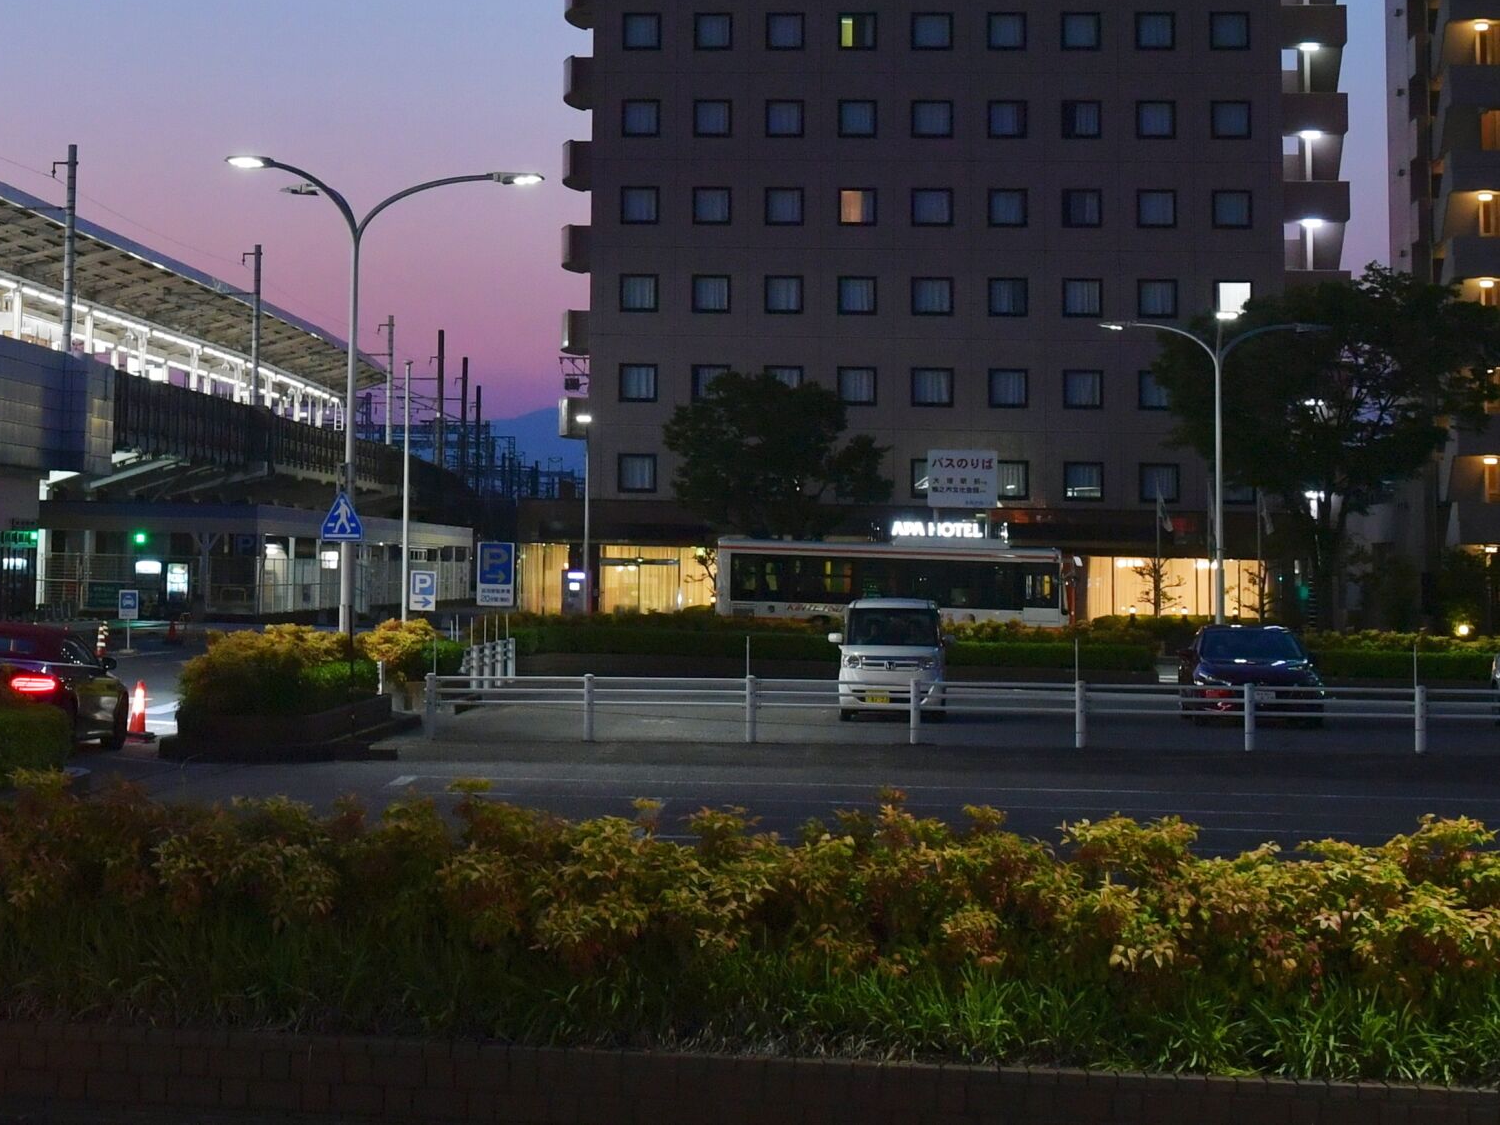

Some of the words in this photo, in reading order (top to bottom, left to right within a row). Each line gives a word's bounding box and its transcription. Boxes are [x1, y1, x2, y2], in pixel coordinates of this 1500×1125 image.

[932, 458, 994, 470] バスのりば
[891, 521, 926, 537] APA
[927, 522, 984, 538] HOTEL
[483, 548, 509, 572] P
[414, 574, 432, 594] P
